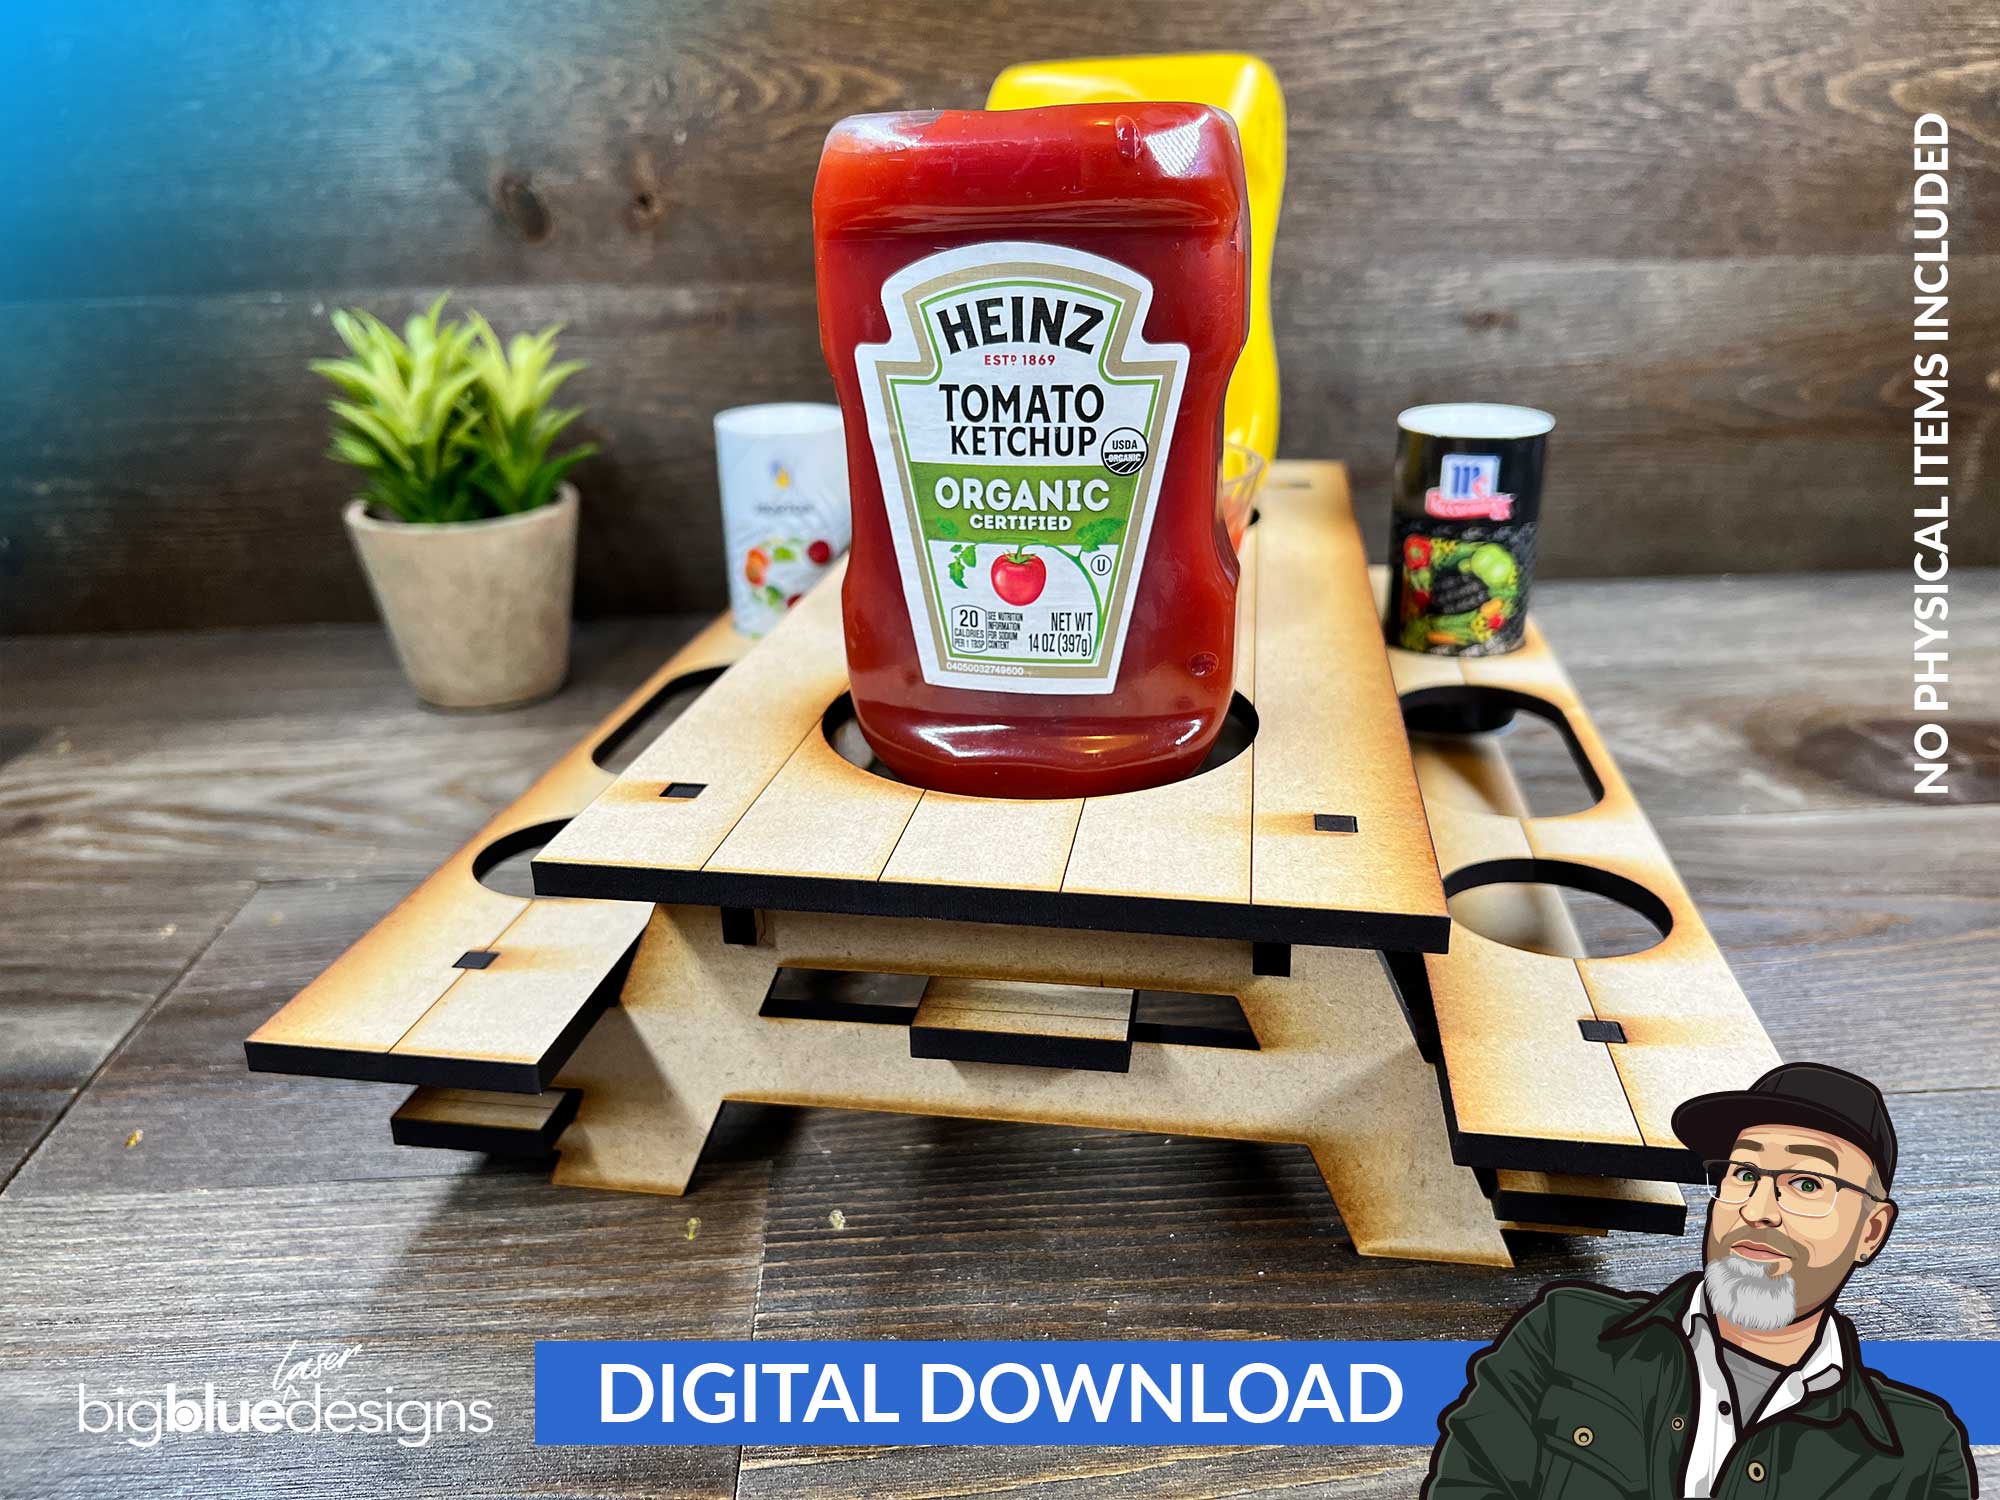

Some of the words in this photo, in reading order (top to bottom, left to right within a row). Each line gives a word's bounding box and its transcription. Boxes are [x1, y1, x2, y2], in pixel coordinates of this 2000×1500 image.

[936, 296, 1104, 355] HEINZ
[1022, 354, 1056, 366] 1869
[938, 383, 1105, 423] TOMATO
[951, 426, 1097, 457] KETCHUP
[1112, 439, 1138, 450] USDA
[1108, 453, 1142, 463] ORGANIC
[934, 476, 1110, 512] ORGANIC
[969, 514, 1073, 531] CERTIFIED
[960, 609, 978, 628] 20
[987, 611, 997, 621] SEE
[998, 612, 1024, 622] NUTRITION
[1051, 612, 1072, 632] NET
[1074, 612, 1093, 632] WT
[987, 621, 1021, 631] INFORMATION
[954, 628, 985, 639] CALORIES
[987, 630, 997, 640] FOR
[998, 631, 1018, 640] SODIUM
[954, 638, 965, 648] PER
[987, 640, 1010, 650] CONTENT
[1028, 633, 1039, 652] 14
[1042, 633, 1056, 652] OZ
[1057, 633, 1092, 656] (397g)
